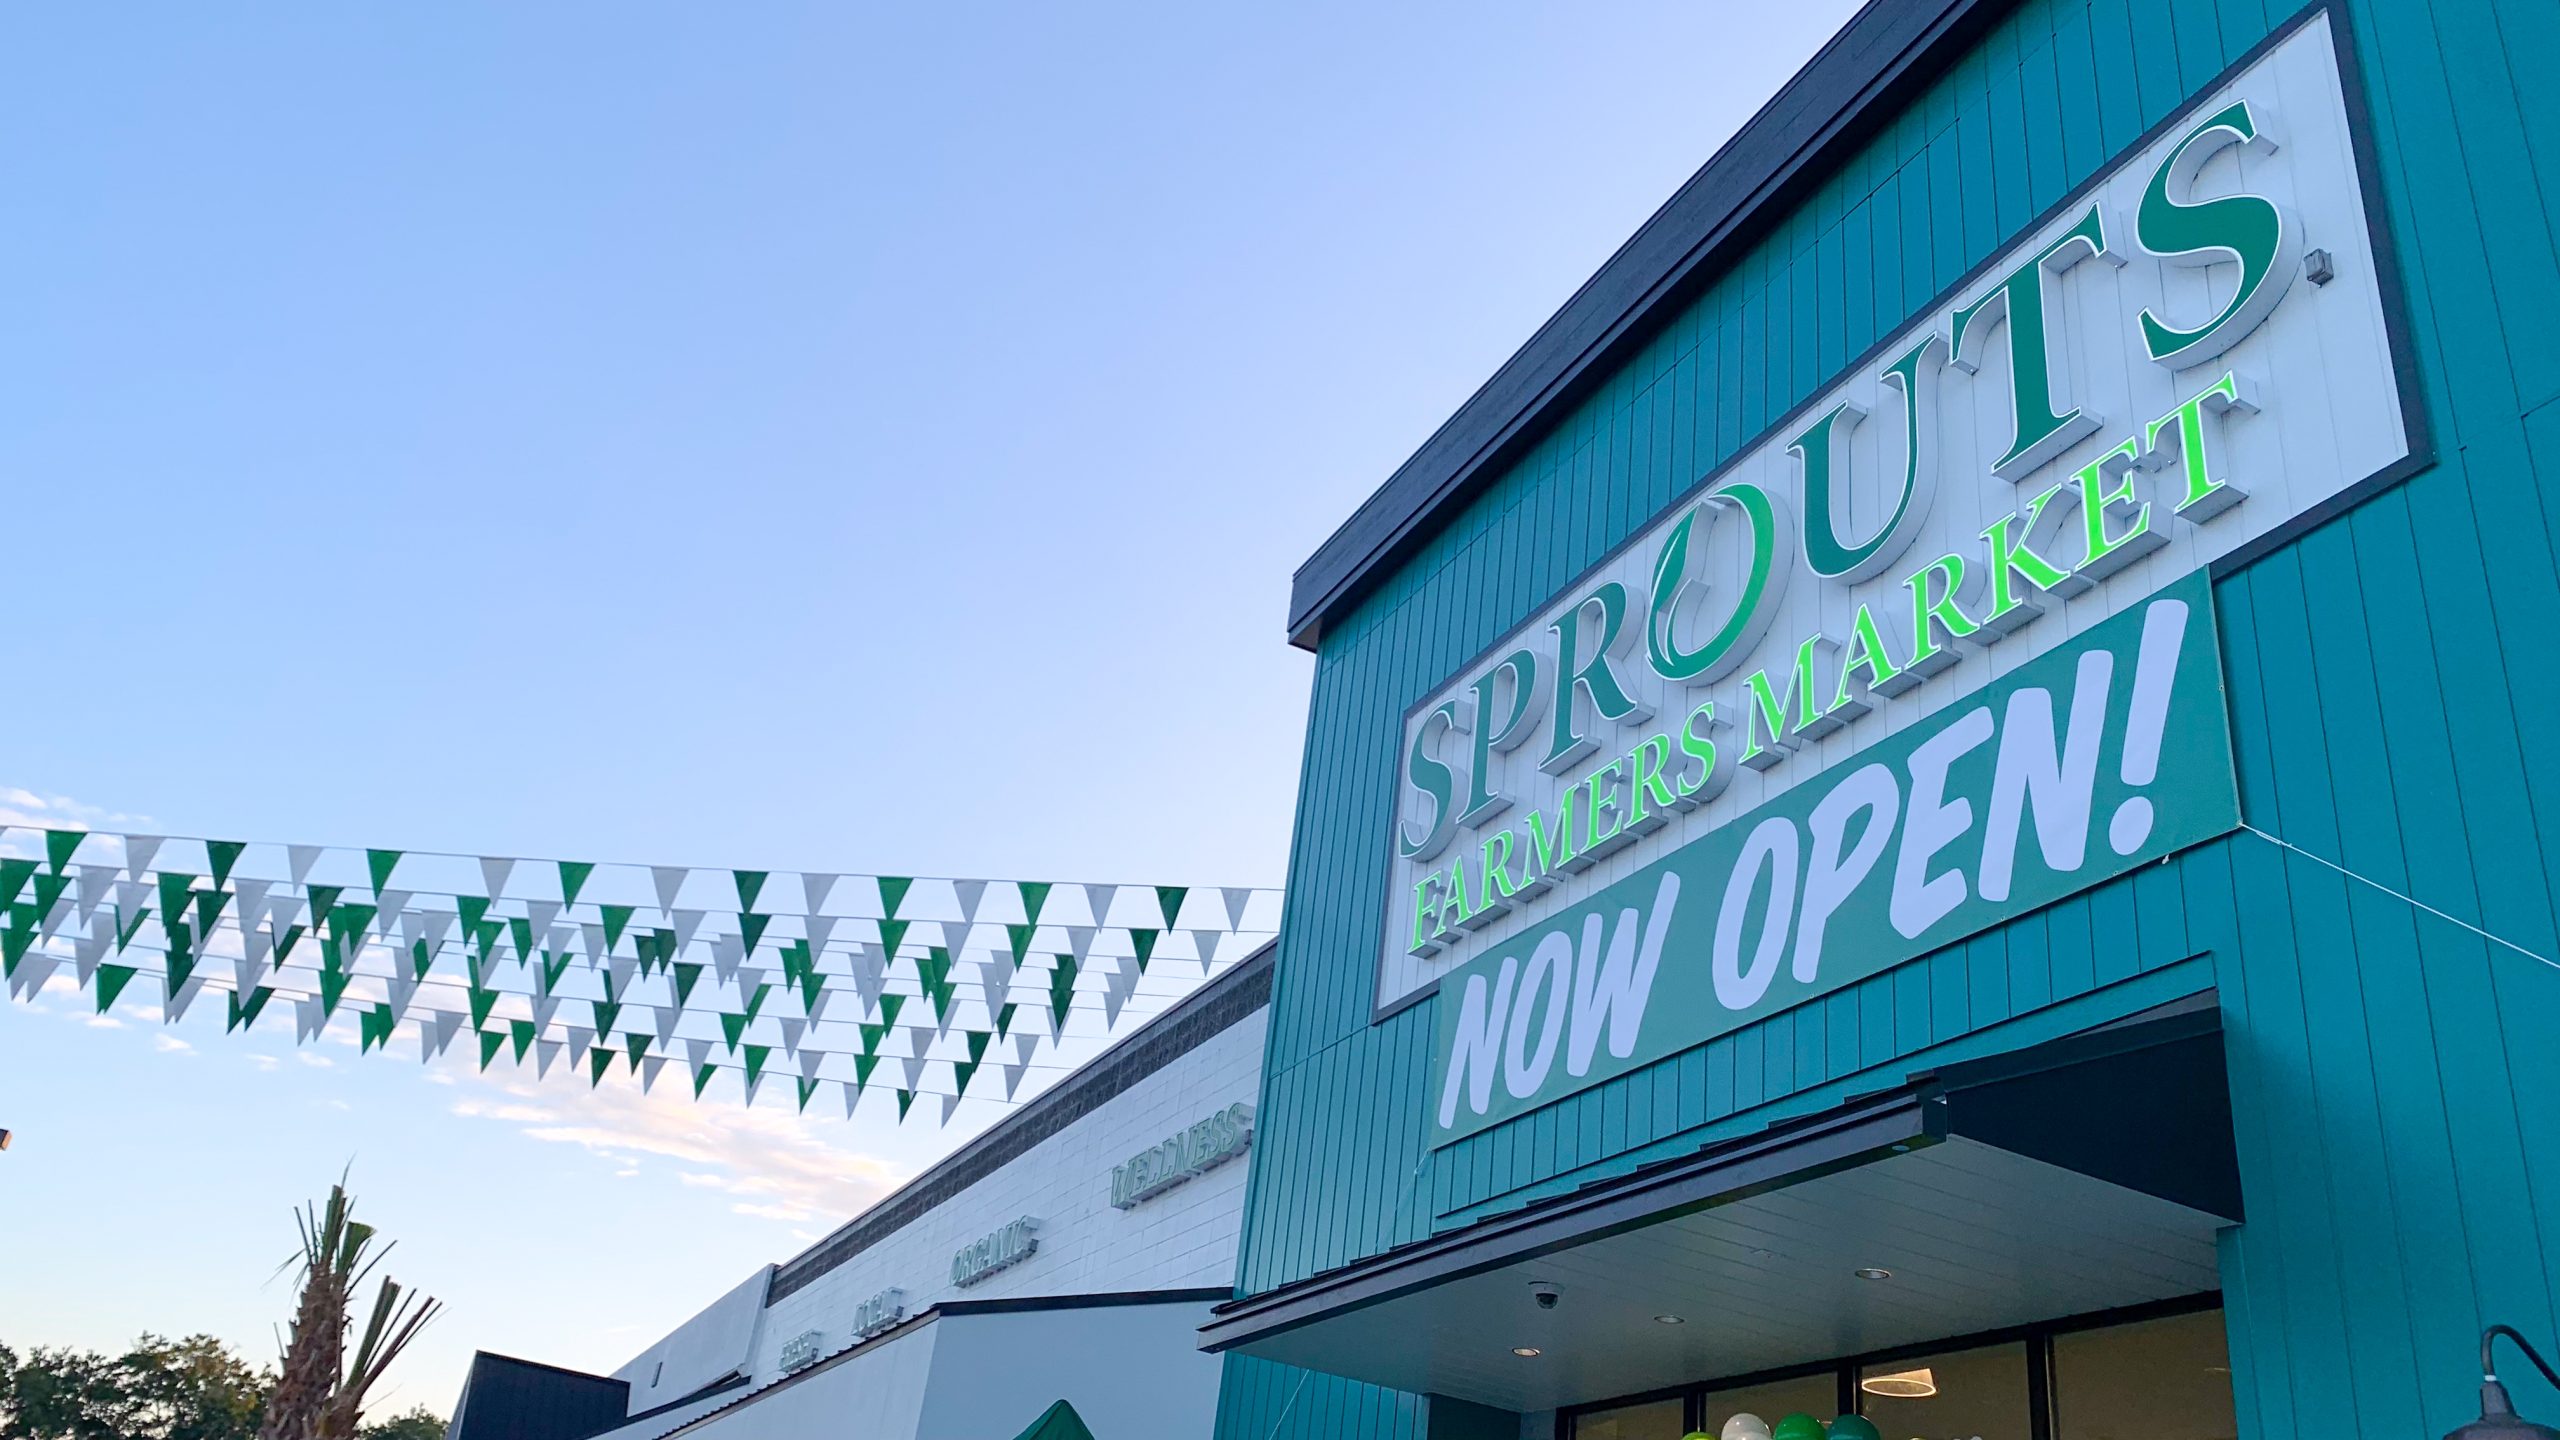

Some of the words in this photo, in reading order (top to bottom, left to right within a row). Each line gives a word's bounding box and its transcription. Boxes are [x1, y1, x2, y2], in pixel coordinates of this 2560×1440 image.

[1399, 98, 2283, 859] SPROUTS
[1407, 700, 1718, 957] FARMERS
[1738, 370, 2239, 767] MARKET
[1437, 870, 1682, 1130] NOW
[1710, 598, 2190, 1011] OPEN!
[949, 1214, 1033, 1288] ORGANIC
[1111, 1102, 1247, 1208] WELLNESS
